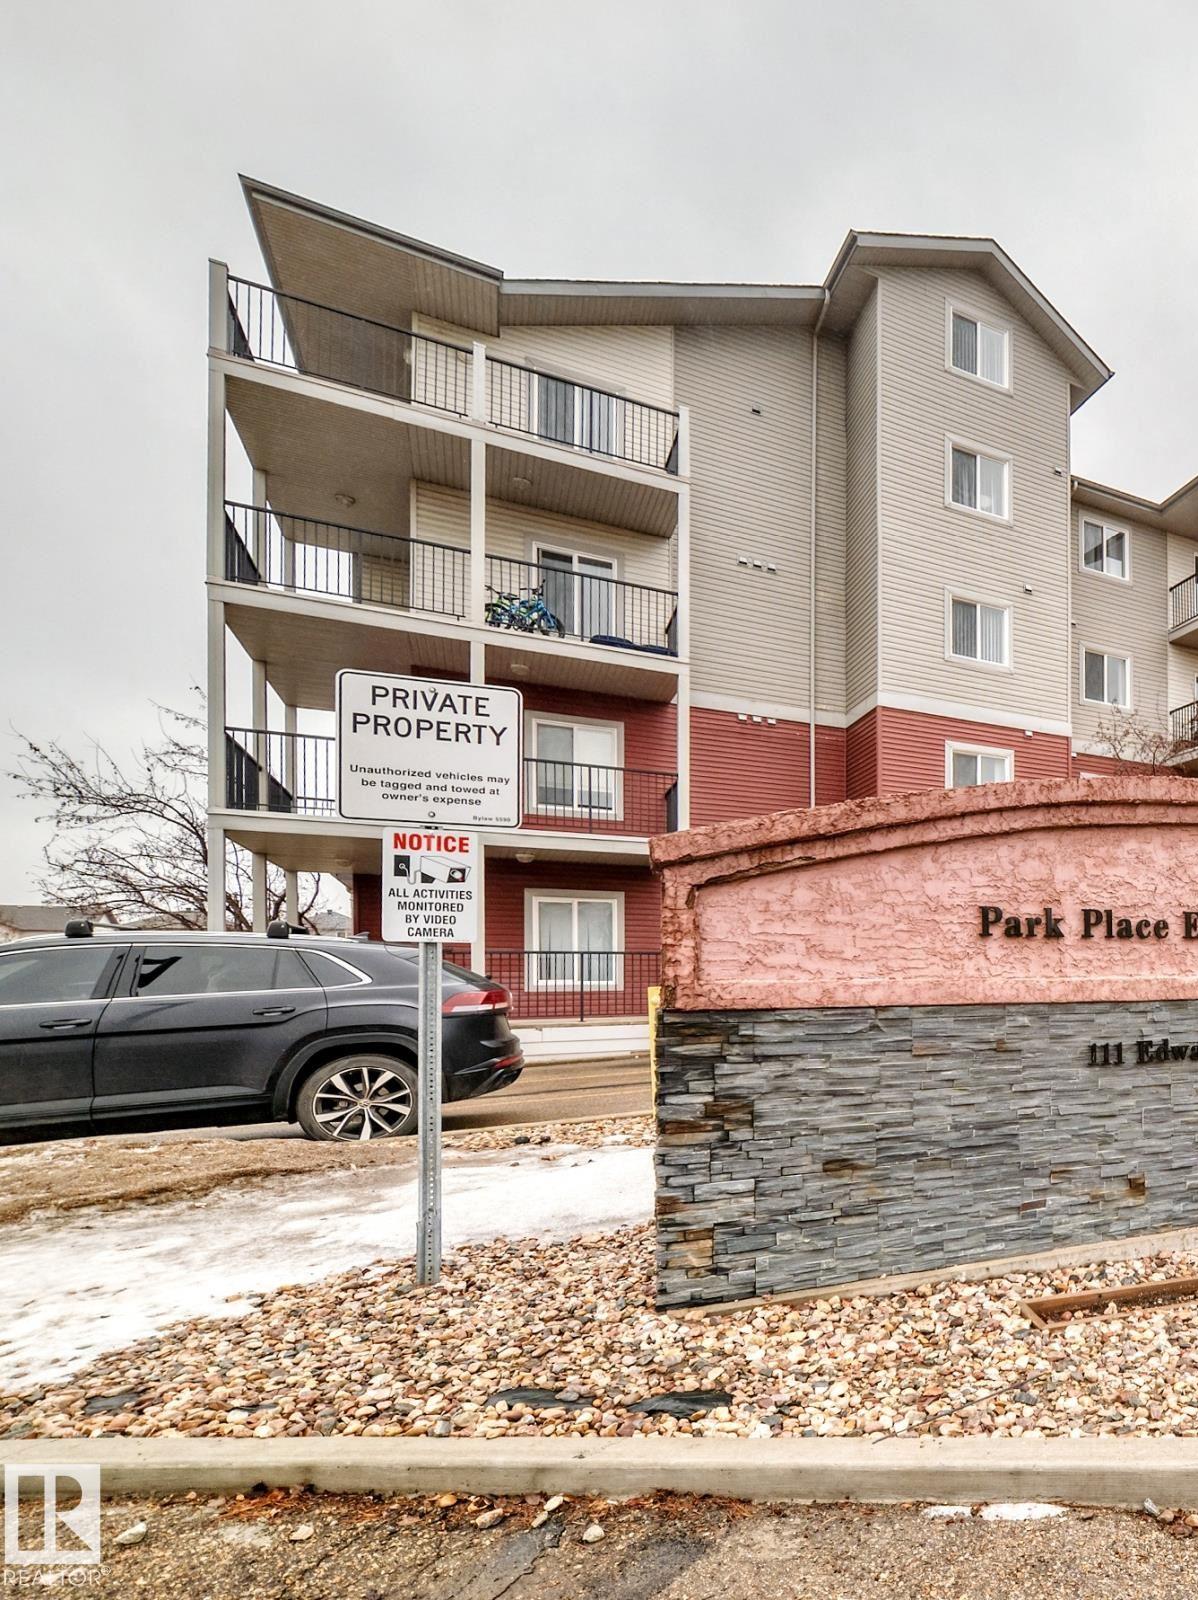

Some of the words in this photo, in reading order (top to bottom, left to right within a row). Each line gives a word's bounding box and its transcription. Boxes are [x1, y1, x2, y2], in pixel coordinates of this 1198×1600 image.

[371, 684, 490, 718] PRIVATE
[352, 712, 508, 746] PROPERTY
[349, 764, 432, 778] Unauthorized
[435, 771, 484, 782] vehicles
[487, 776, 511, 786] may
[361, 778, 377, 787] be
[380, 780, 422, 791] tagged
[425, 783, 448, 792] and
[451, 785, 486, 794] towed
[489, 788, 500, 796] at
[381, 792, 429, 803] owner's
[432, 796, 482, 806] expense
[393, 832, 470, 854] NOTICE
[388, 888, 409, 899] ALL
[412, 888, 473, 900] ACTIVITIES
[397, 901, 464, 913] MONITORED
[405, 914, 420, 925] BY
[423, 914, 457, 925] VIDEO
[978, 905, 1065, 939] Park
[1081, 908, 1170, 940] Place
[407, 926, 455, 938] CAMERA
[1087, 1041, 1125, 1067] 111
